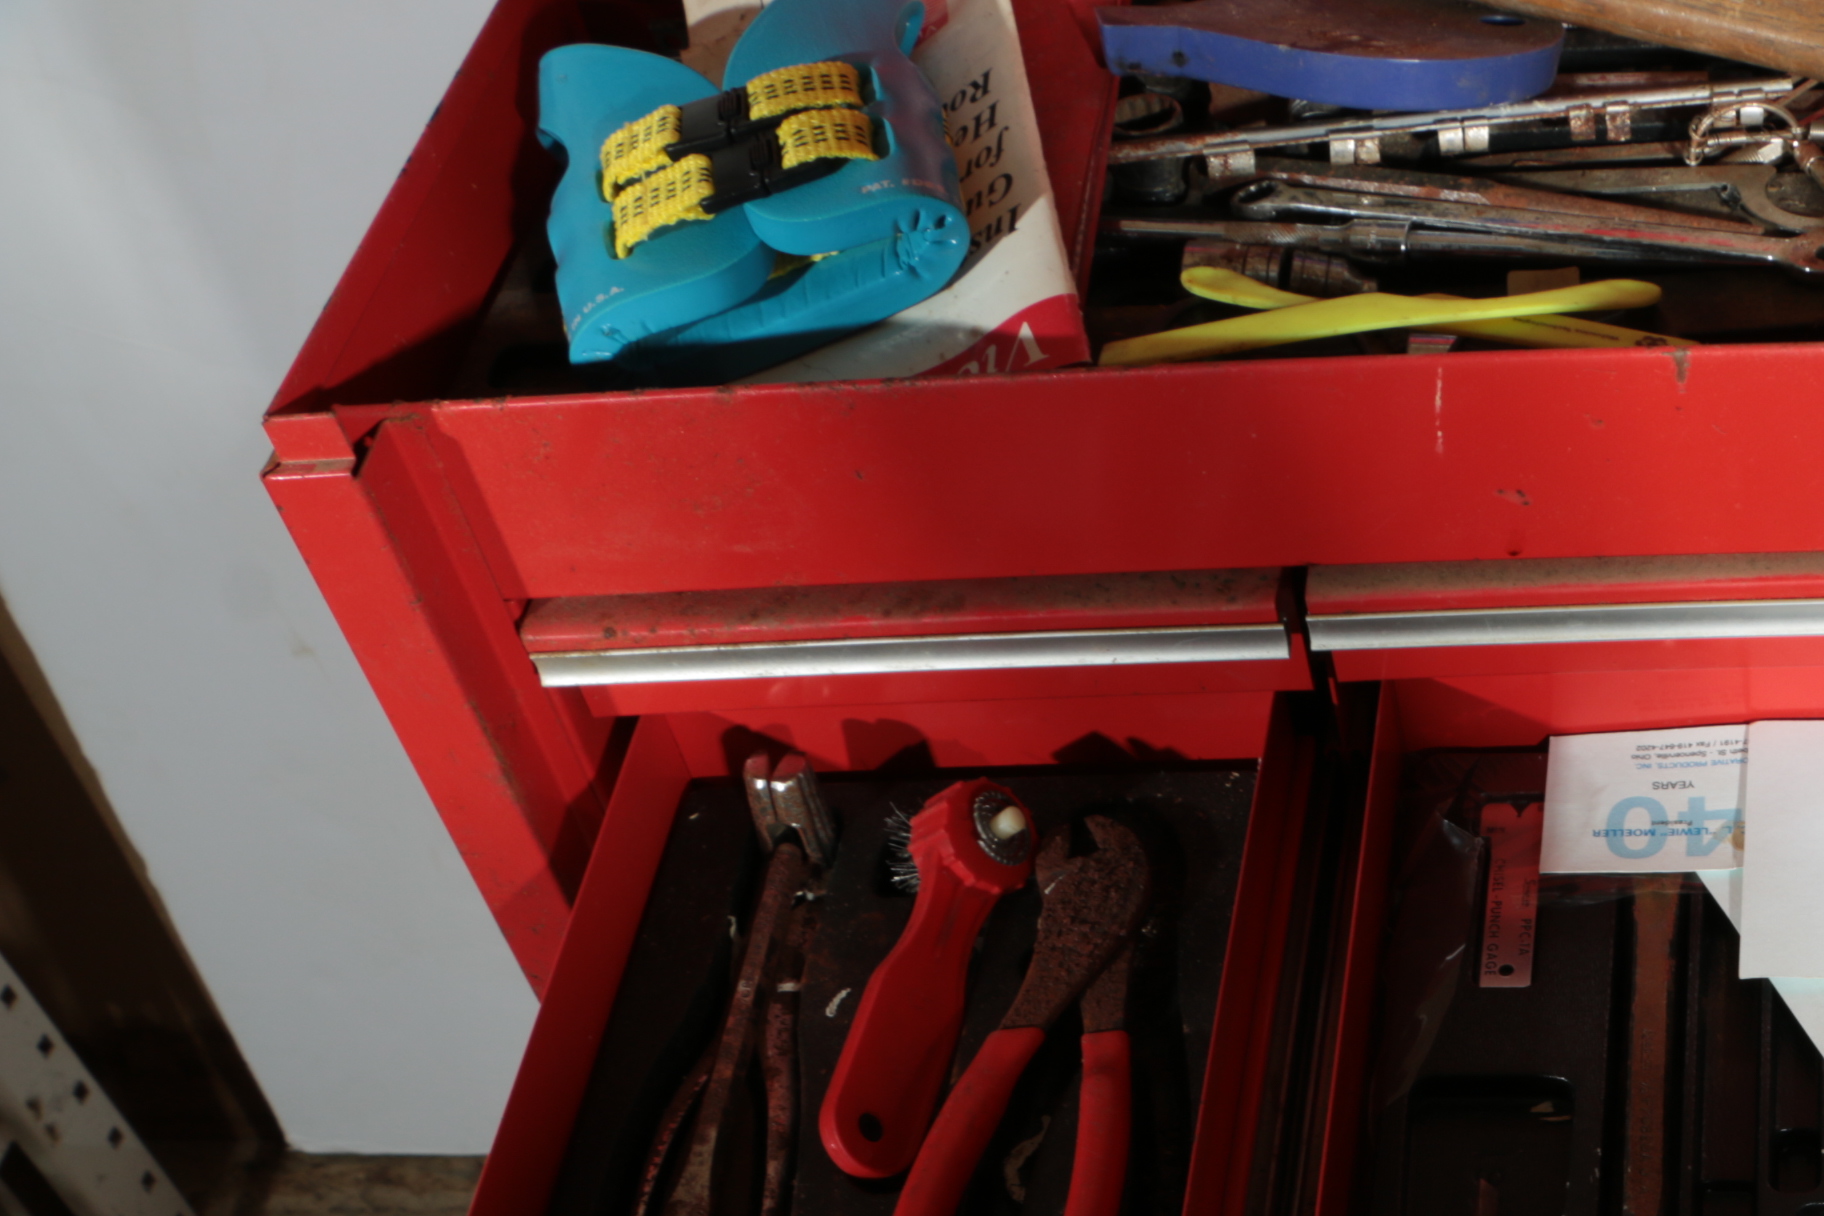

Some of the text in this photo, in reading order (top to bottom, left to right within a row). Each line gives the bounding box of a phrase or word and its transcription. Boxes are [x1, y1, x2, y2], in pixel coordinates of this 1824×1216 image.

[942, 67, 992, 113] Ro
[958, 126, 1009, 183] for
[1631, 753, 1652, 761] Ohio
[1651, 780, 1695, 790] YEARS
[1592, 828, 1656, 838] MOELLER
[1606, 796, 1742, 859] 40
[1484, 943, 1500, 976] GAGE
